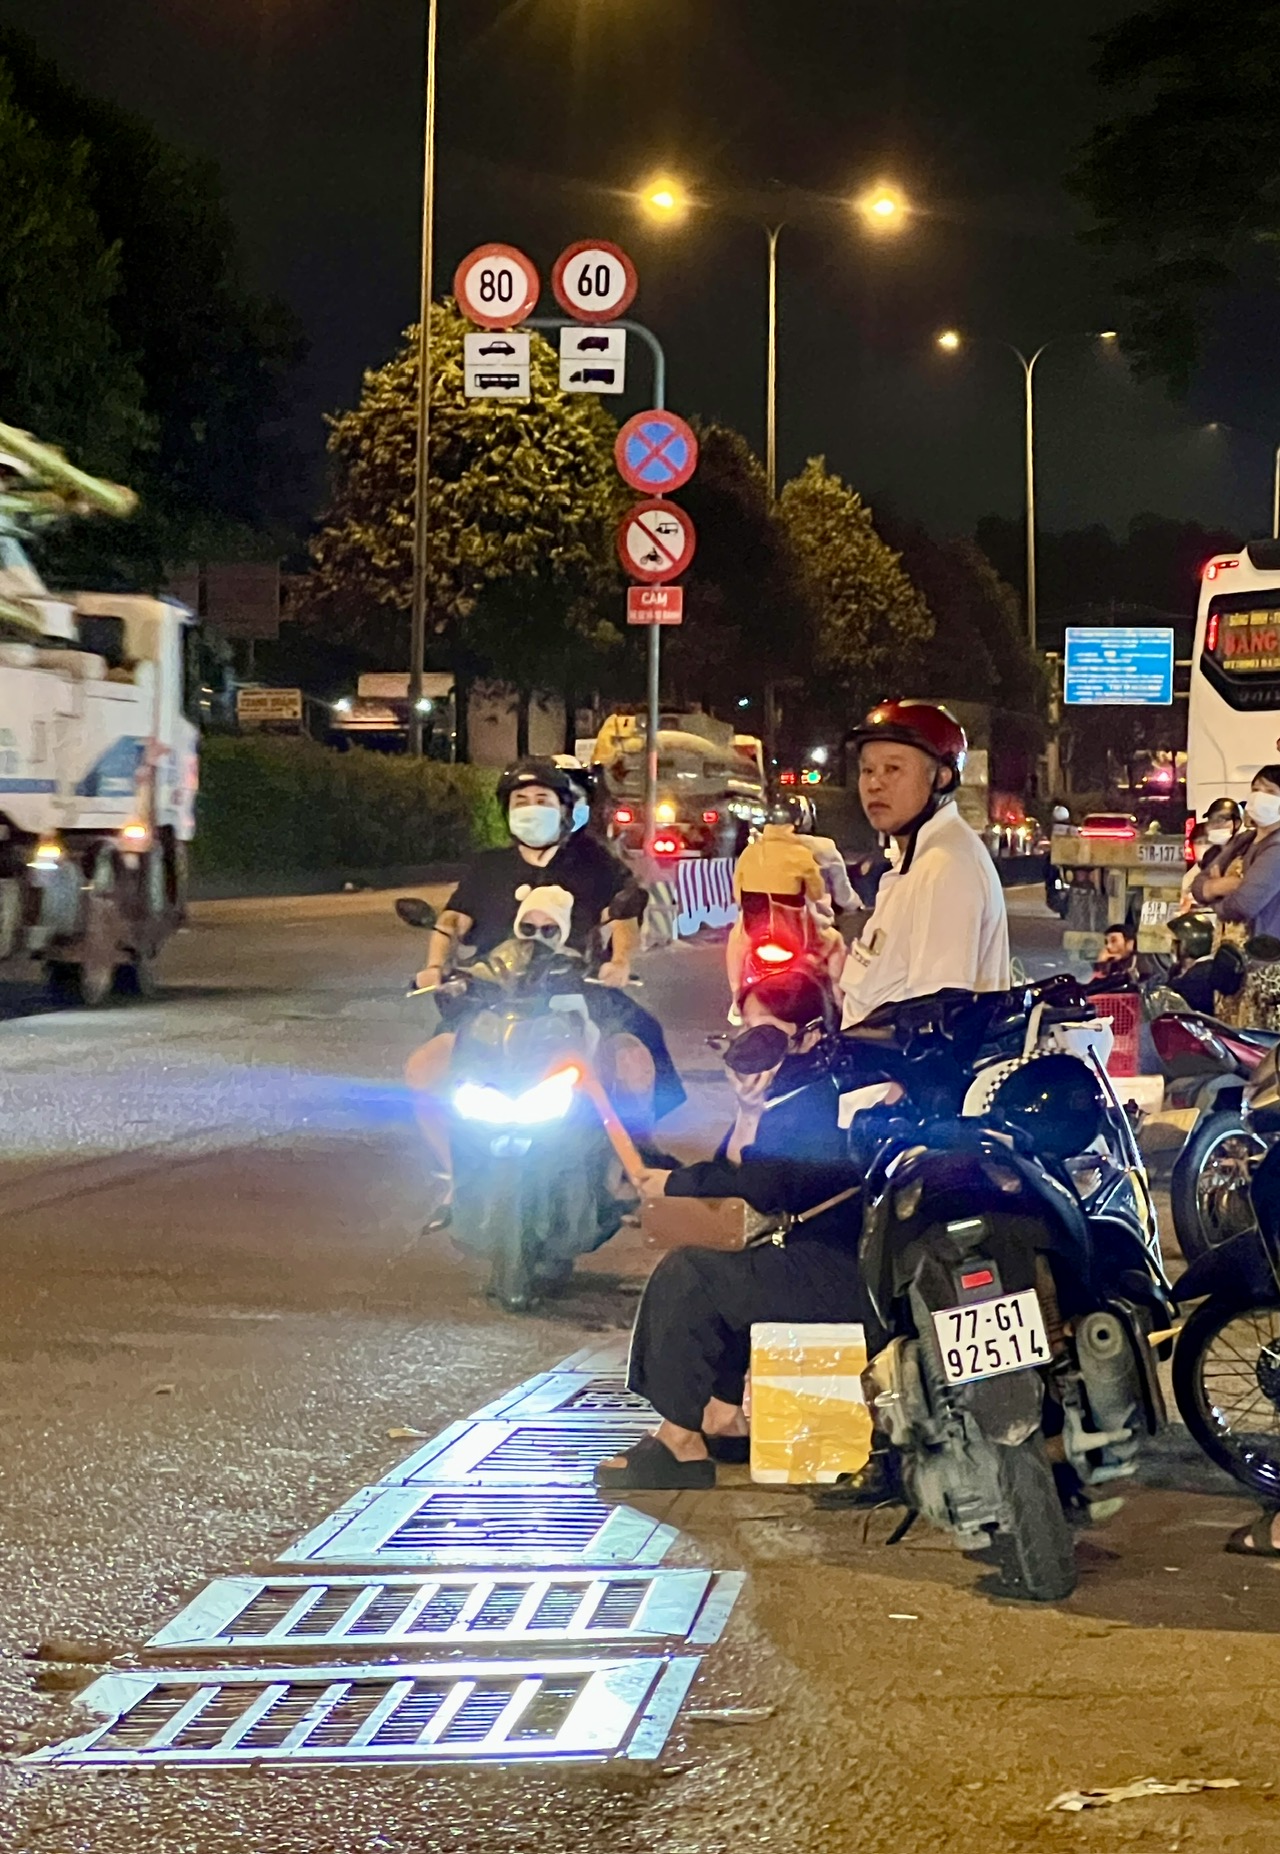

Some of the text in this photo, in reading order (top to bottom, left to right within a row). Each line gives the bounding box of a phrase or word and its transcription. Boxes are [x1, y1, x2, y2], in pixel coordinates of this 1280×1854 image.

[479, 269, 514, 303] 80
[577, 264, 610, 297] 60
[949, 1299, 1024, 1343] 77-G1
[948, 1329, 1044, 1377] 925.14
